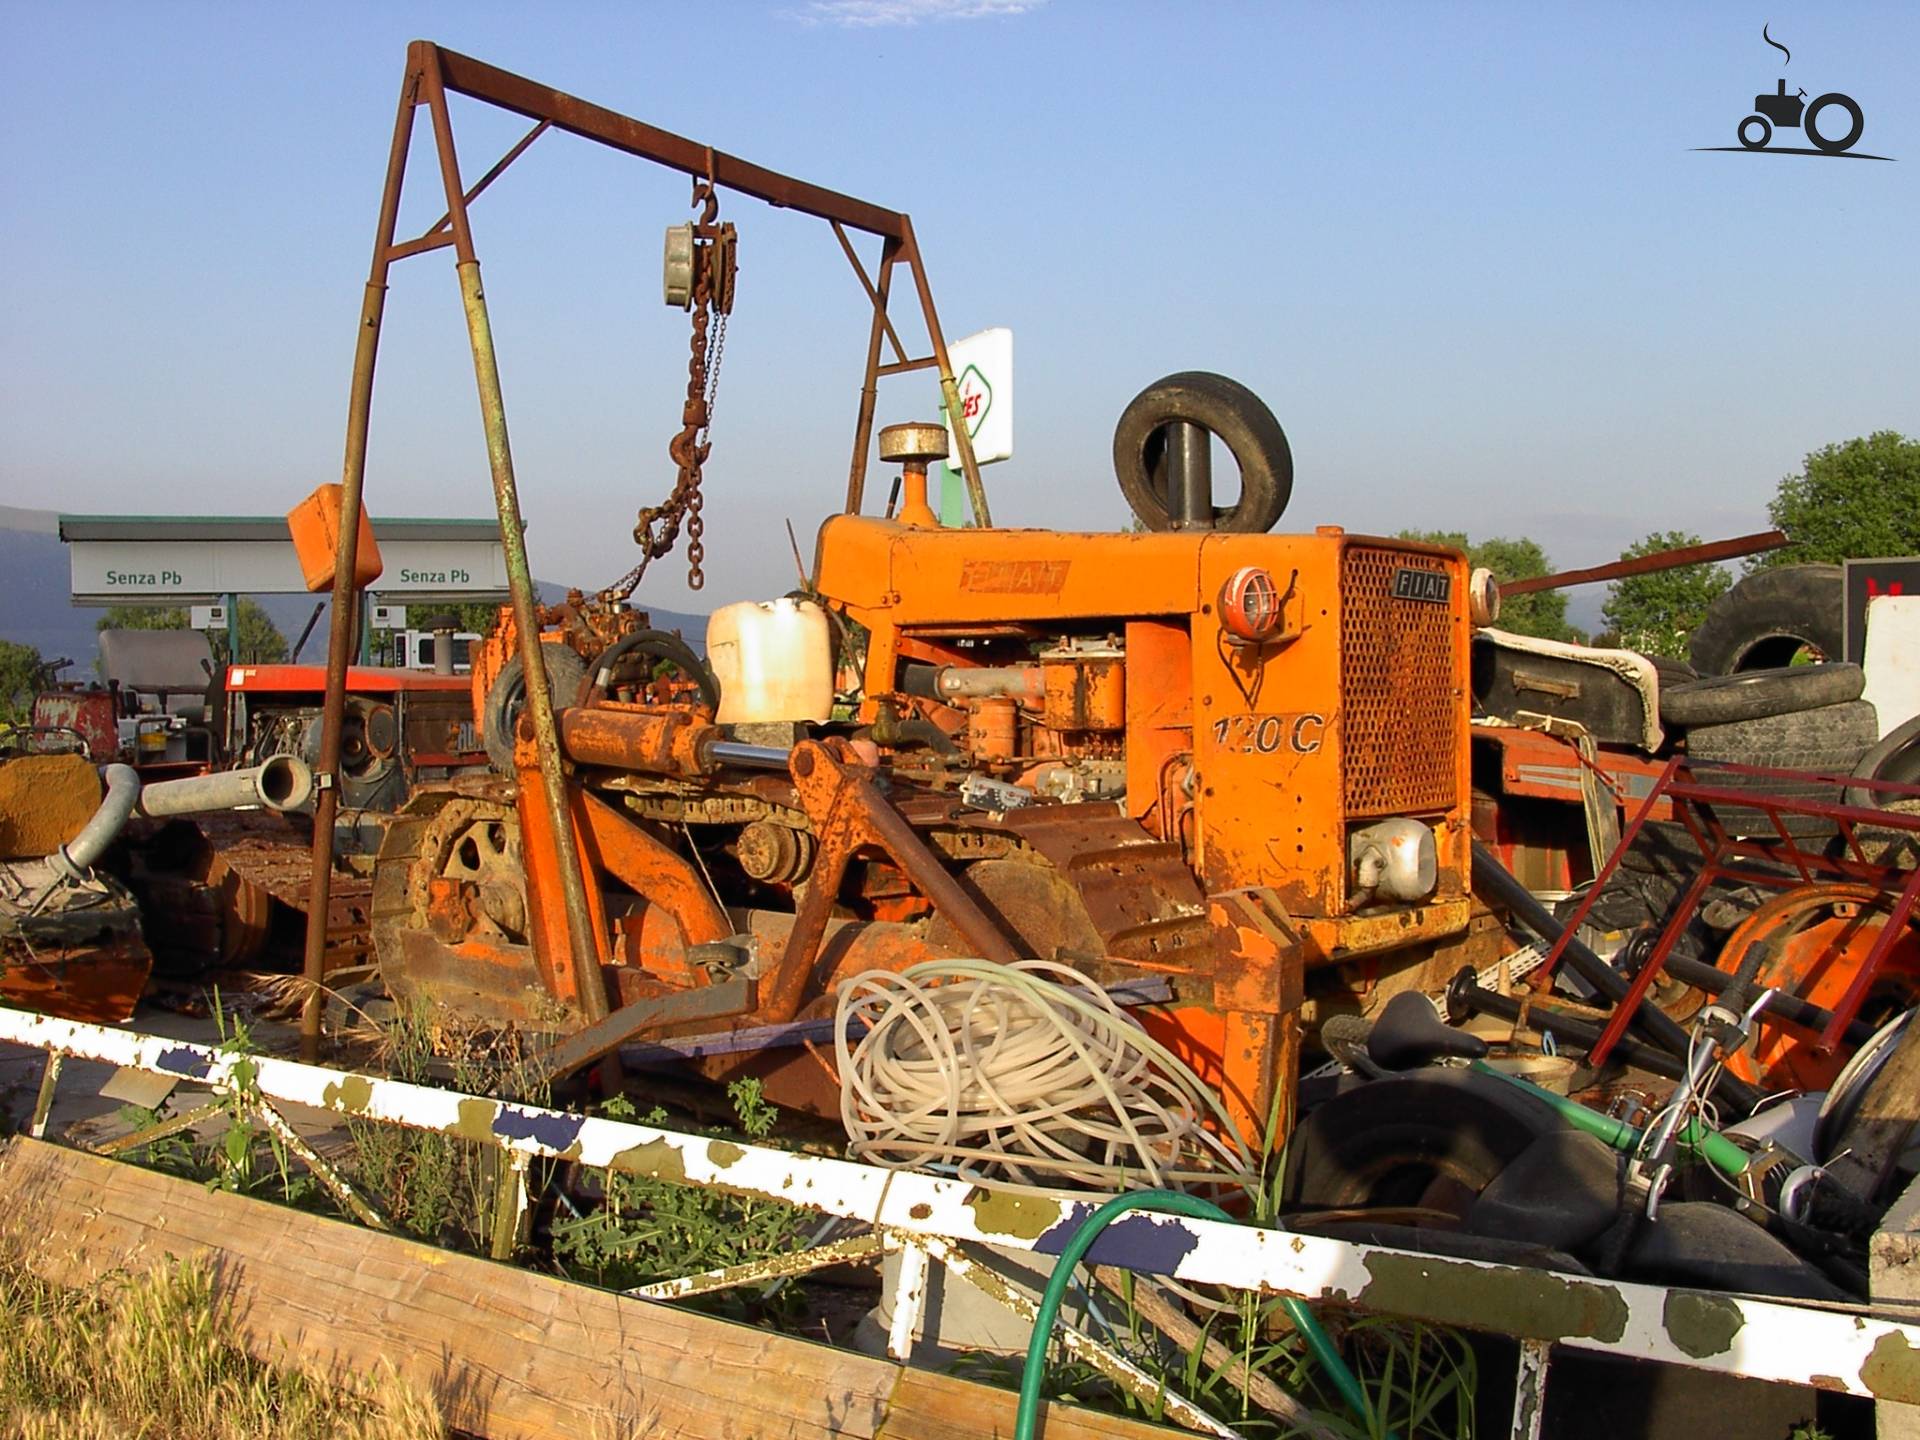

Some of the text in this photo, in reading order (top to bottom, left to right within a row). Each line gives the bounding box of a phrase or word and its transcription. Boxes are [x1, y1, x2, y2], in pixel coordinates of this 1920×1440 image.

[106, 570, 182, 585] Senza Pb
[400, 568, 470, 583] Senza Pb
[1399, 574, 1448, 597] FIAT
[1291, 713, 1324, 753] C
